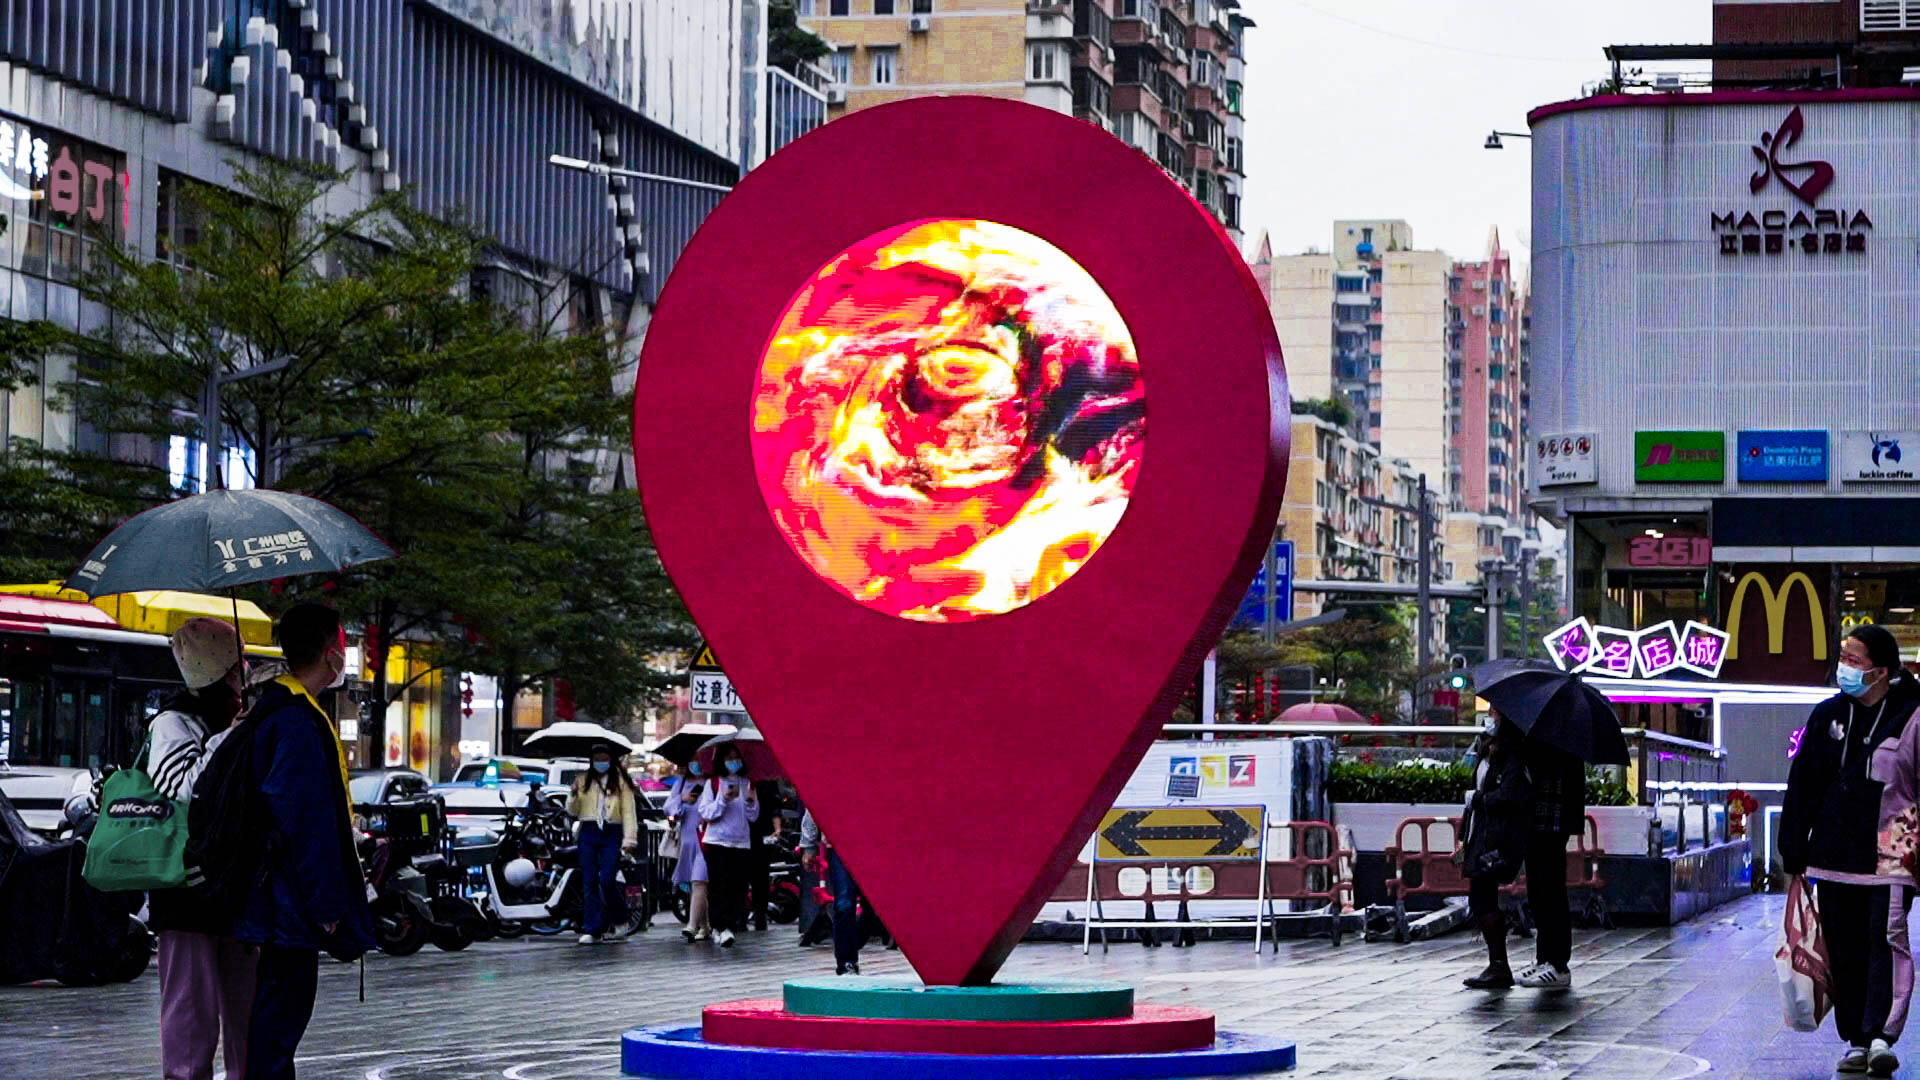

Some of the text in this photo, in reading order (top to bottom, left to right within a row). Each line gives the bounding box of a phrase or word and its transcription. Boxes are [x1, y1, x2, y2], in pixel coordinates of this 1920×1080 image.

[1711, 209, 1873, 231] MACARIA
[1859, 469, 1914, 479] luckin coffee
[1603, 635, 1720, 671] 名店城
